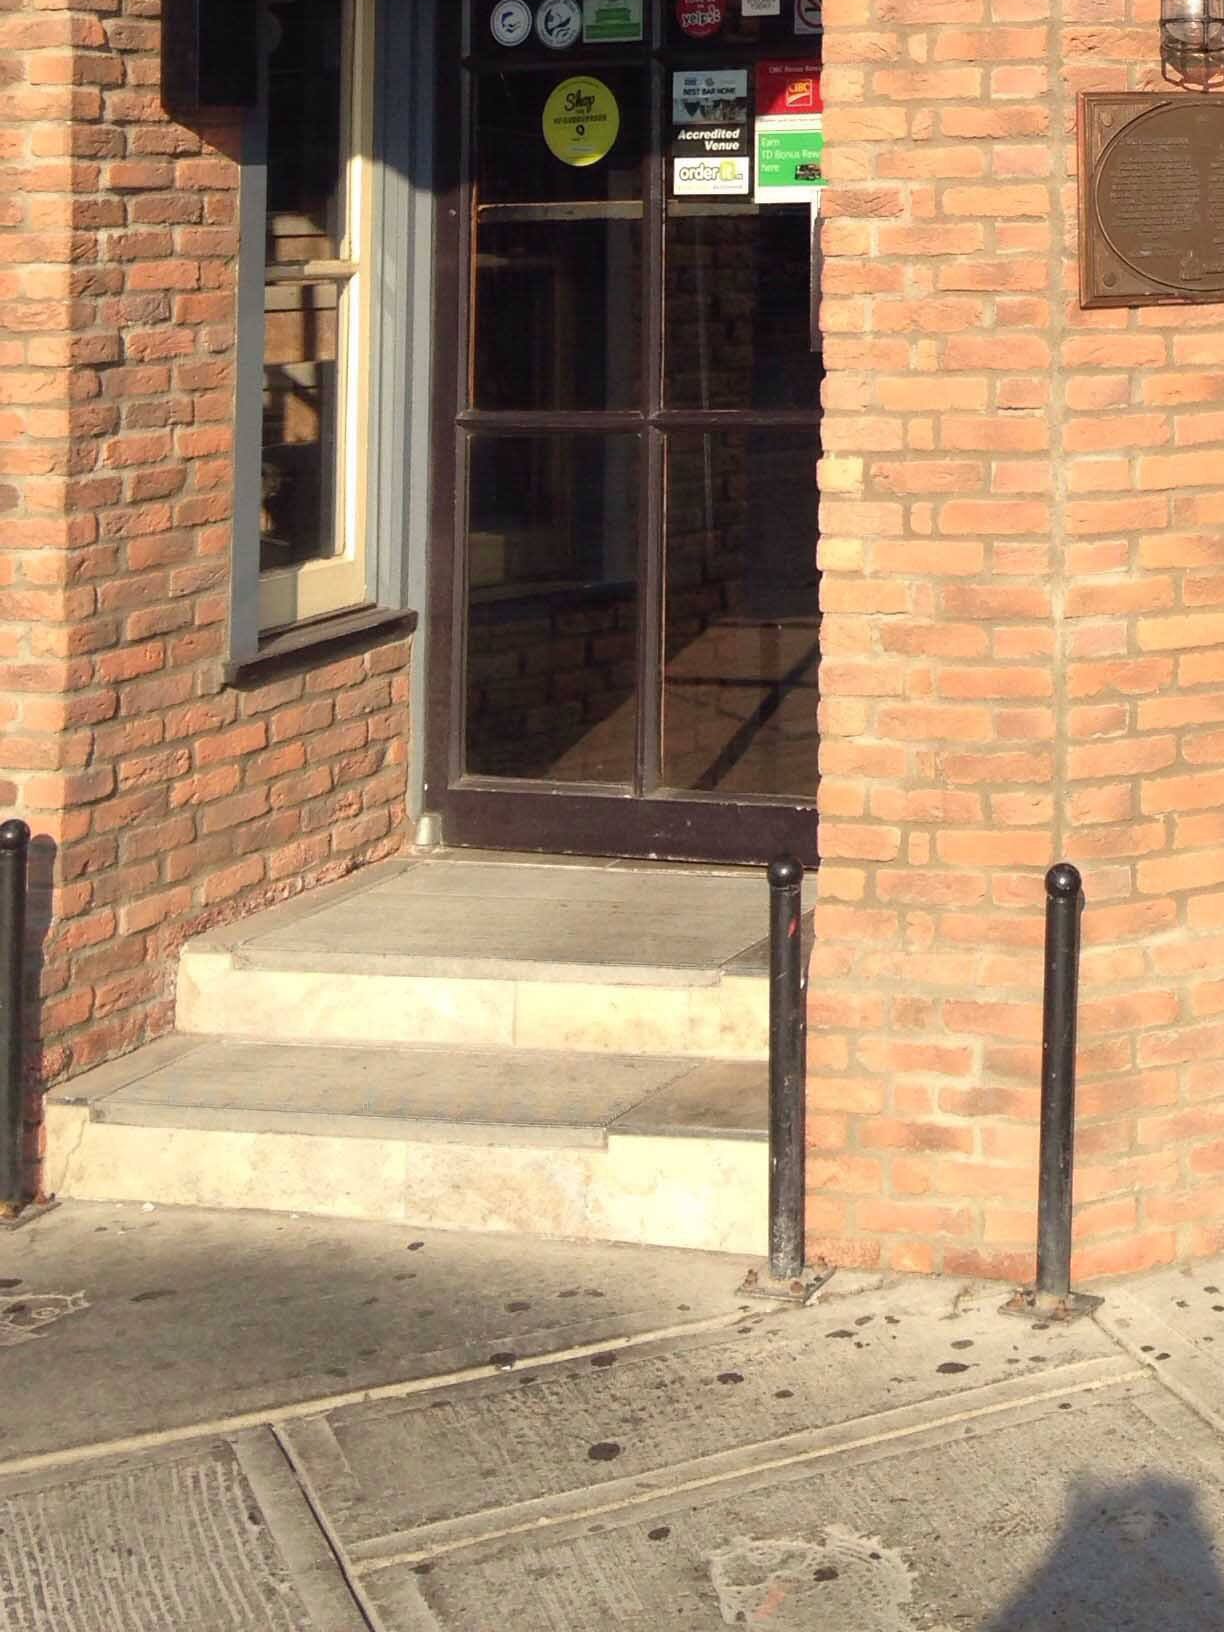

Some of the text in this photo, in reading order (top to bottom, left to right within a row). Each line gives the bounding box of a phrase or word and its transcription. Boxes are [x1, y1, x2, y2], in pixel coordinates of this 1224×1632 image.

[681, 10, 714, 28] yelp
[678, 128, 741, 140] Accredited
[704, 140, 740, 151] Venue
